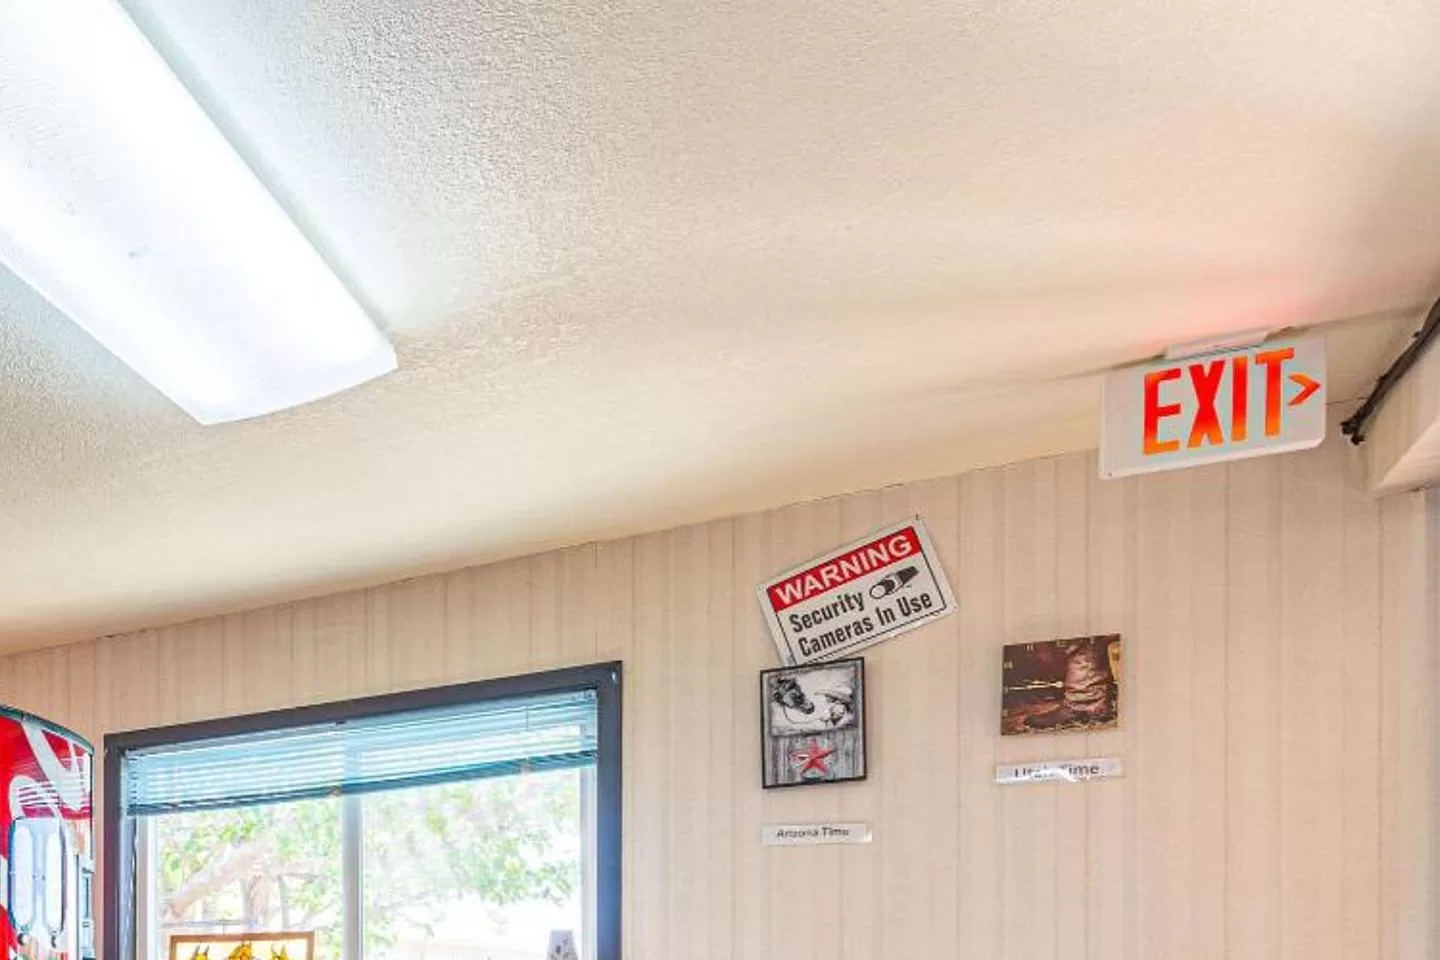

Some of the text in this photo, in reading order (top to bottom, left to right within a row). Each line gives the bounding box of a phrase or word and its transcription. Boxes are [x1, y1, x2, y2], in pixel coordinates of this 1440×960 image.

[1142, 346, 1296, 456] EXIT
[775, 534, 914, 606] WARNING
[788, 591, 866, 634] Security
[798, 591, 933, 658] Cameras In Use
[821, 826, 850, 838] Time
